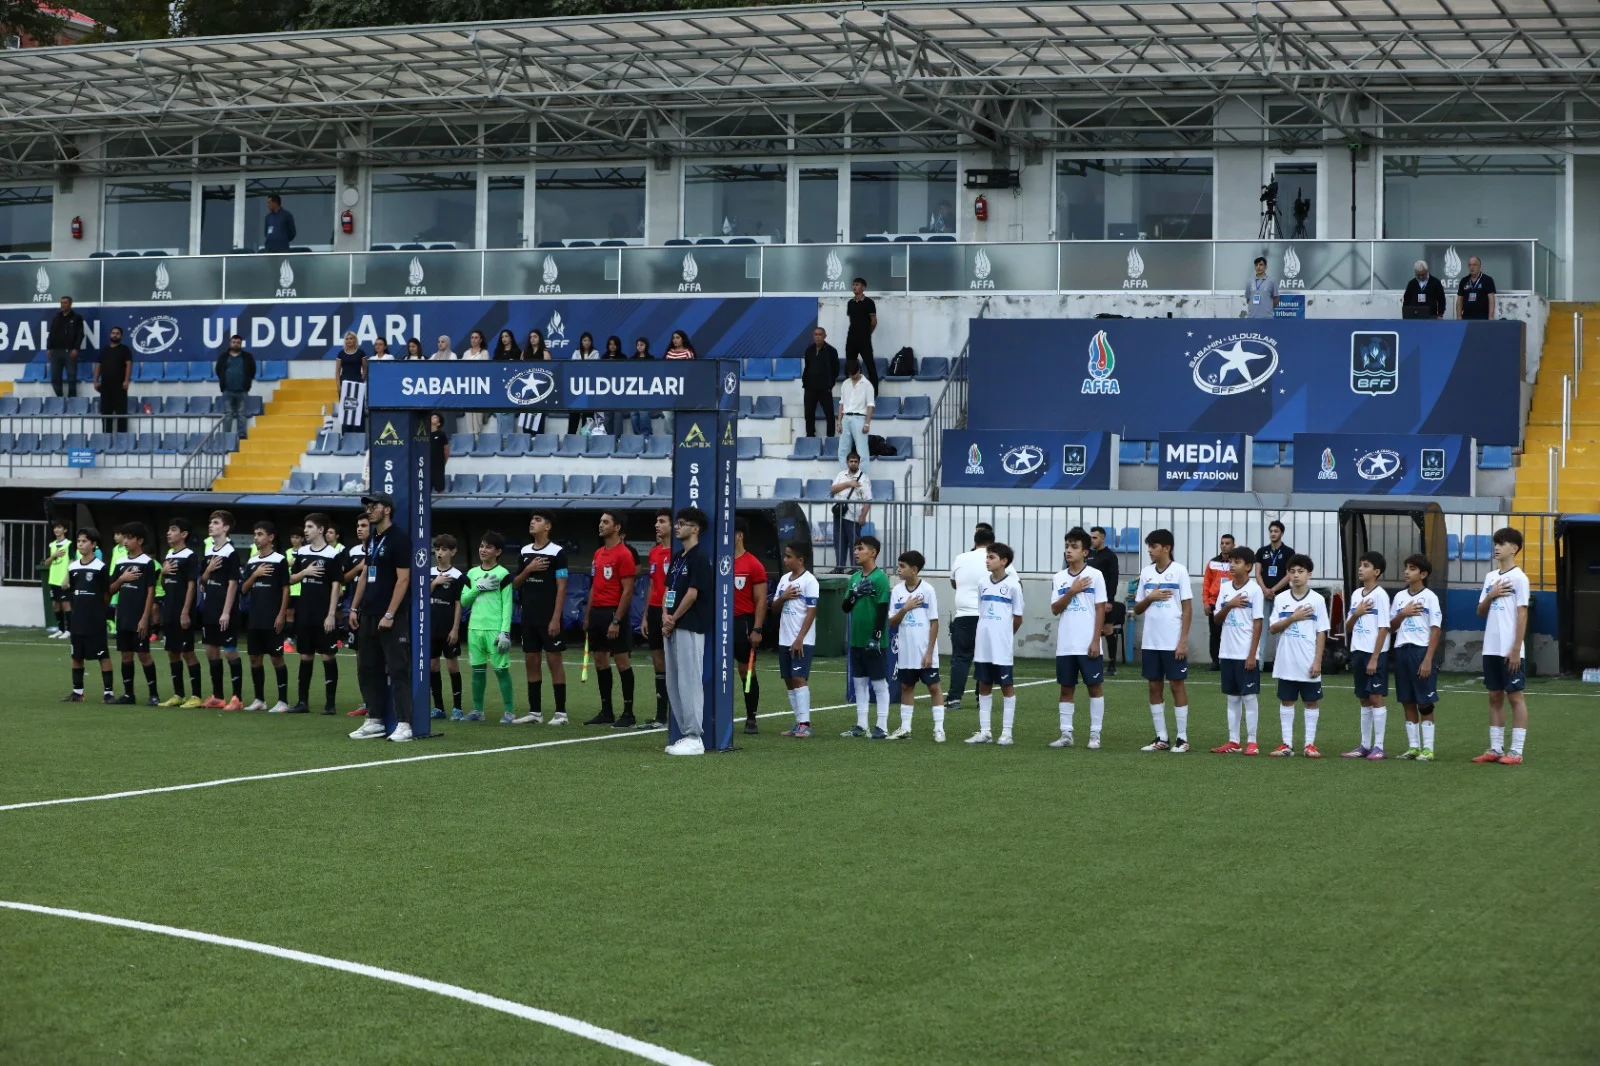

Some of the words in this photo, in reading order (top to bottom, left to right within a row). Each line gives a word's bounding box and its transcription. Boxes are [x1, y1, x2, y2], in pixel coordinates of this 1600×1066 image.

[678, 282, 701, 292] AFFA
[822, 280, 846, 290] AFFA
[970, 279, 995, 289] AFFA
[1122, 278, 1148, 289] AFFA
[1279, 279, 1305, 288] AFFA
[1441, 279, 1459, 288] AFF
[275, 288, 297, 297] AFFA
[405, 286, 427, 295] AFFA
[539, 284, 561, 294] AFFA
[32, 293, 52, 302] AFFA
[152, 290, 172, 299] AFFA
[203, 313, 421, 348] ULDUZLARI
[1189, 338, 1223, 368] SABAHIN
[1228, 332, 1278, 347] ULDUZLARI
[401, 376, 490, 395] SABAHIN
[570, 376, 684, 395] ULDUZLARI
[1081, 378, 1120, 394] AFFA
[1358, 378, 1391, 388] BFF
[1212, 386, 1235, 394] BFF
[1166, 439, 1239, 464] MEDİA
[965, 465, 984, 474] AFFA
[1166, 470, 1191, 480] BAYIL
[1193, 469, 1239, 480] STADİONU
[1318, 470, 1338, 479] AFFA
